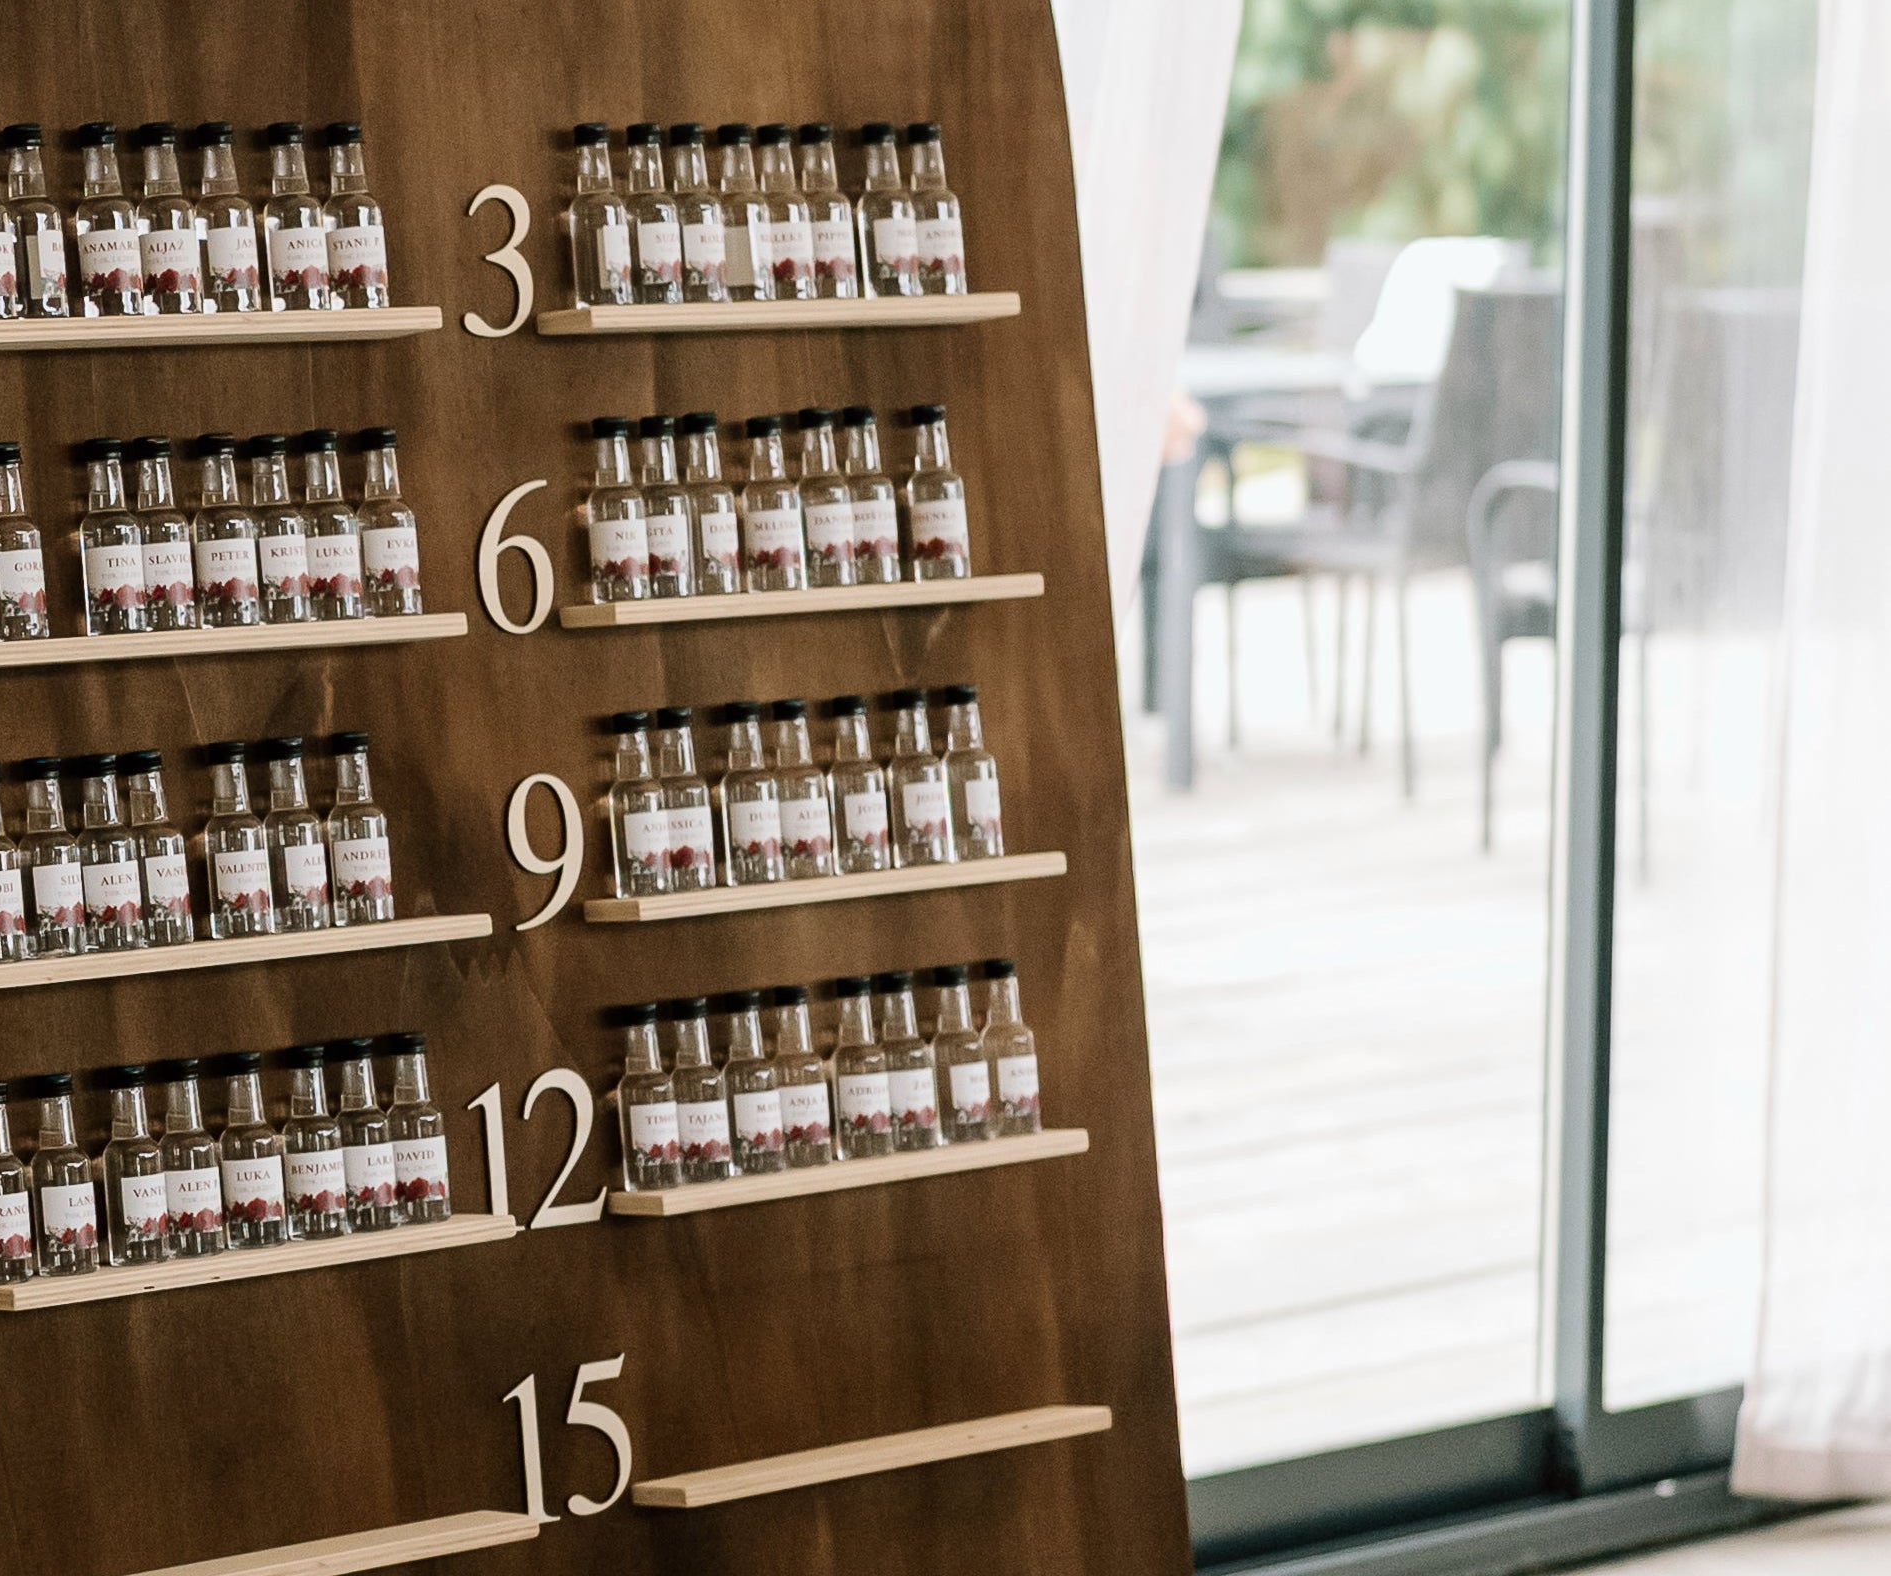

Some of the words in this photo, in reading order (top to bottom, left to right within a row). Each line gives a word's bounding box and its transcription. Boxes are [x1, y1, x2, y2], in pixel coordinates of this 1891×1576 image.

[464, 184, 534, 338] 3
[106, 557, 136, 569] TINA
[211, 550, 250, 562] PETER
[478, 479, 554, 634] 6
[508, 773, 584, 931] 9
[237, 1170, 270, 1181] LUKA
[396, 1149, 435, 1162] DAVID
[465, 1068, 607, 1232] 12
[503, 1353, 632, 1526] 15
